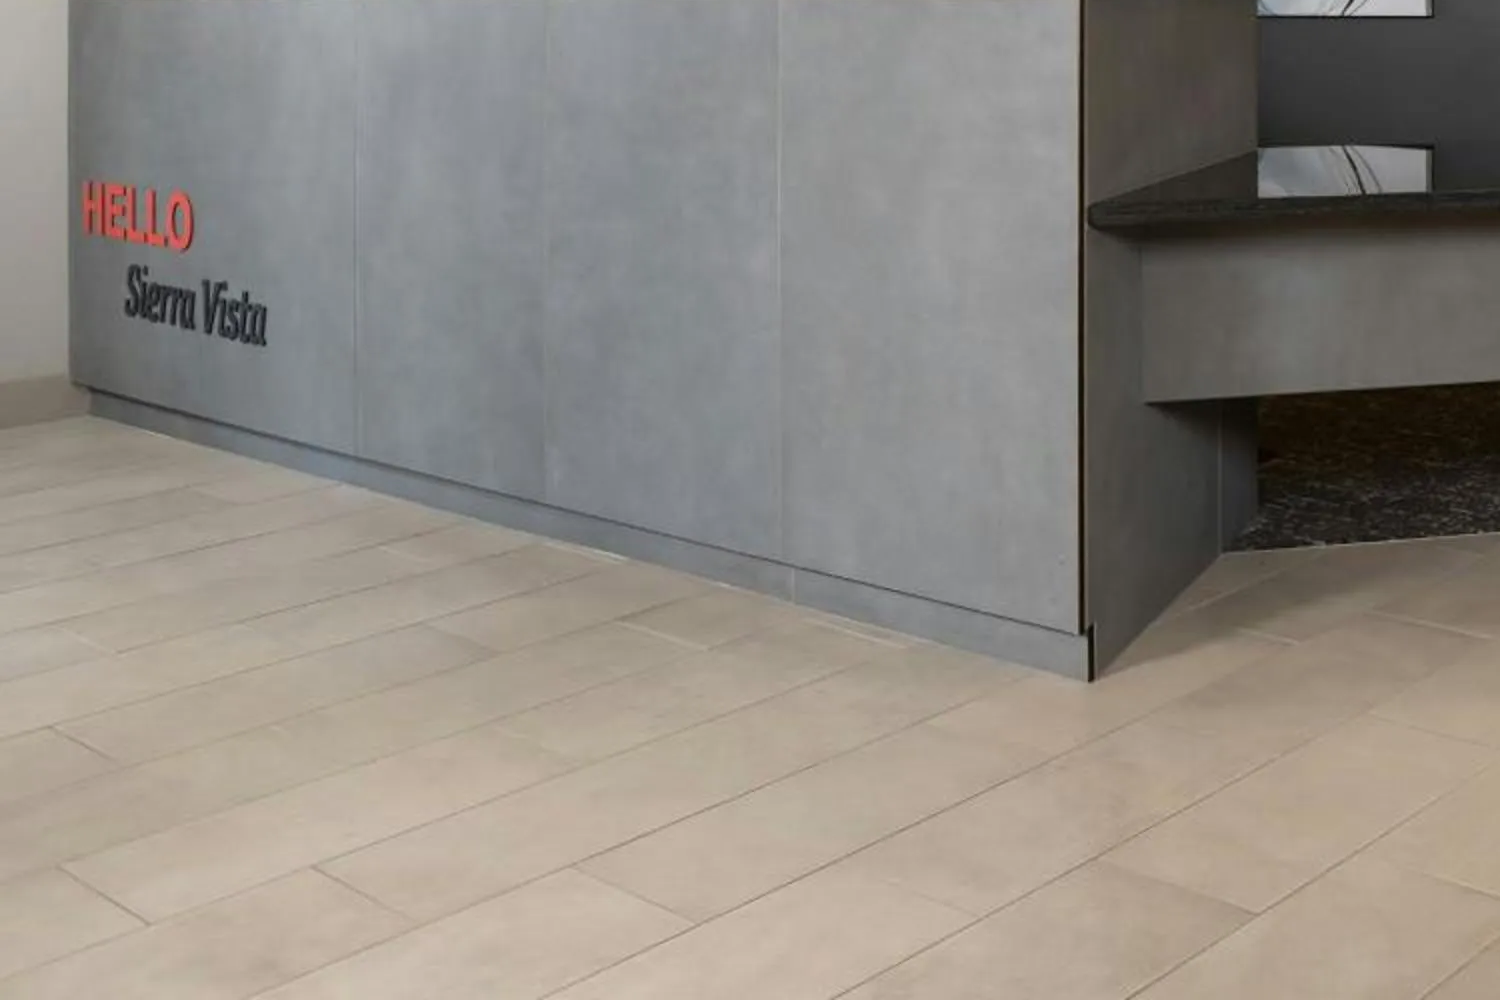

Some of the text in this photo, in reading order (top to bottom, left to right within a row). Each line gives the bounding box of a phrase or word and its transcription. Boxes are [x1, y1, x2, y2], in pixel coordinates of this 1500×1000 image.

[82, 179, 195, 254] HELLO
[124, 263, 268, 348] Sierra Vista
